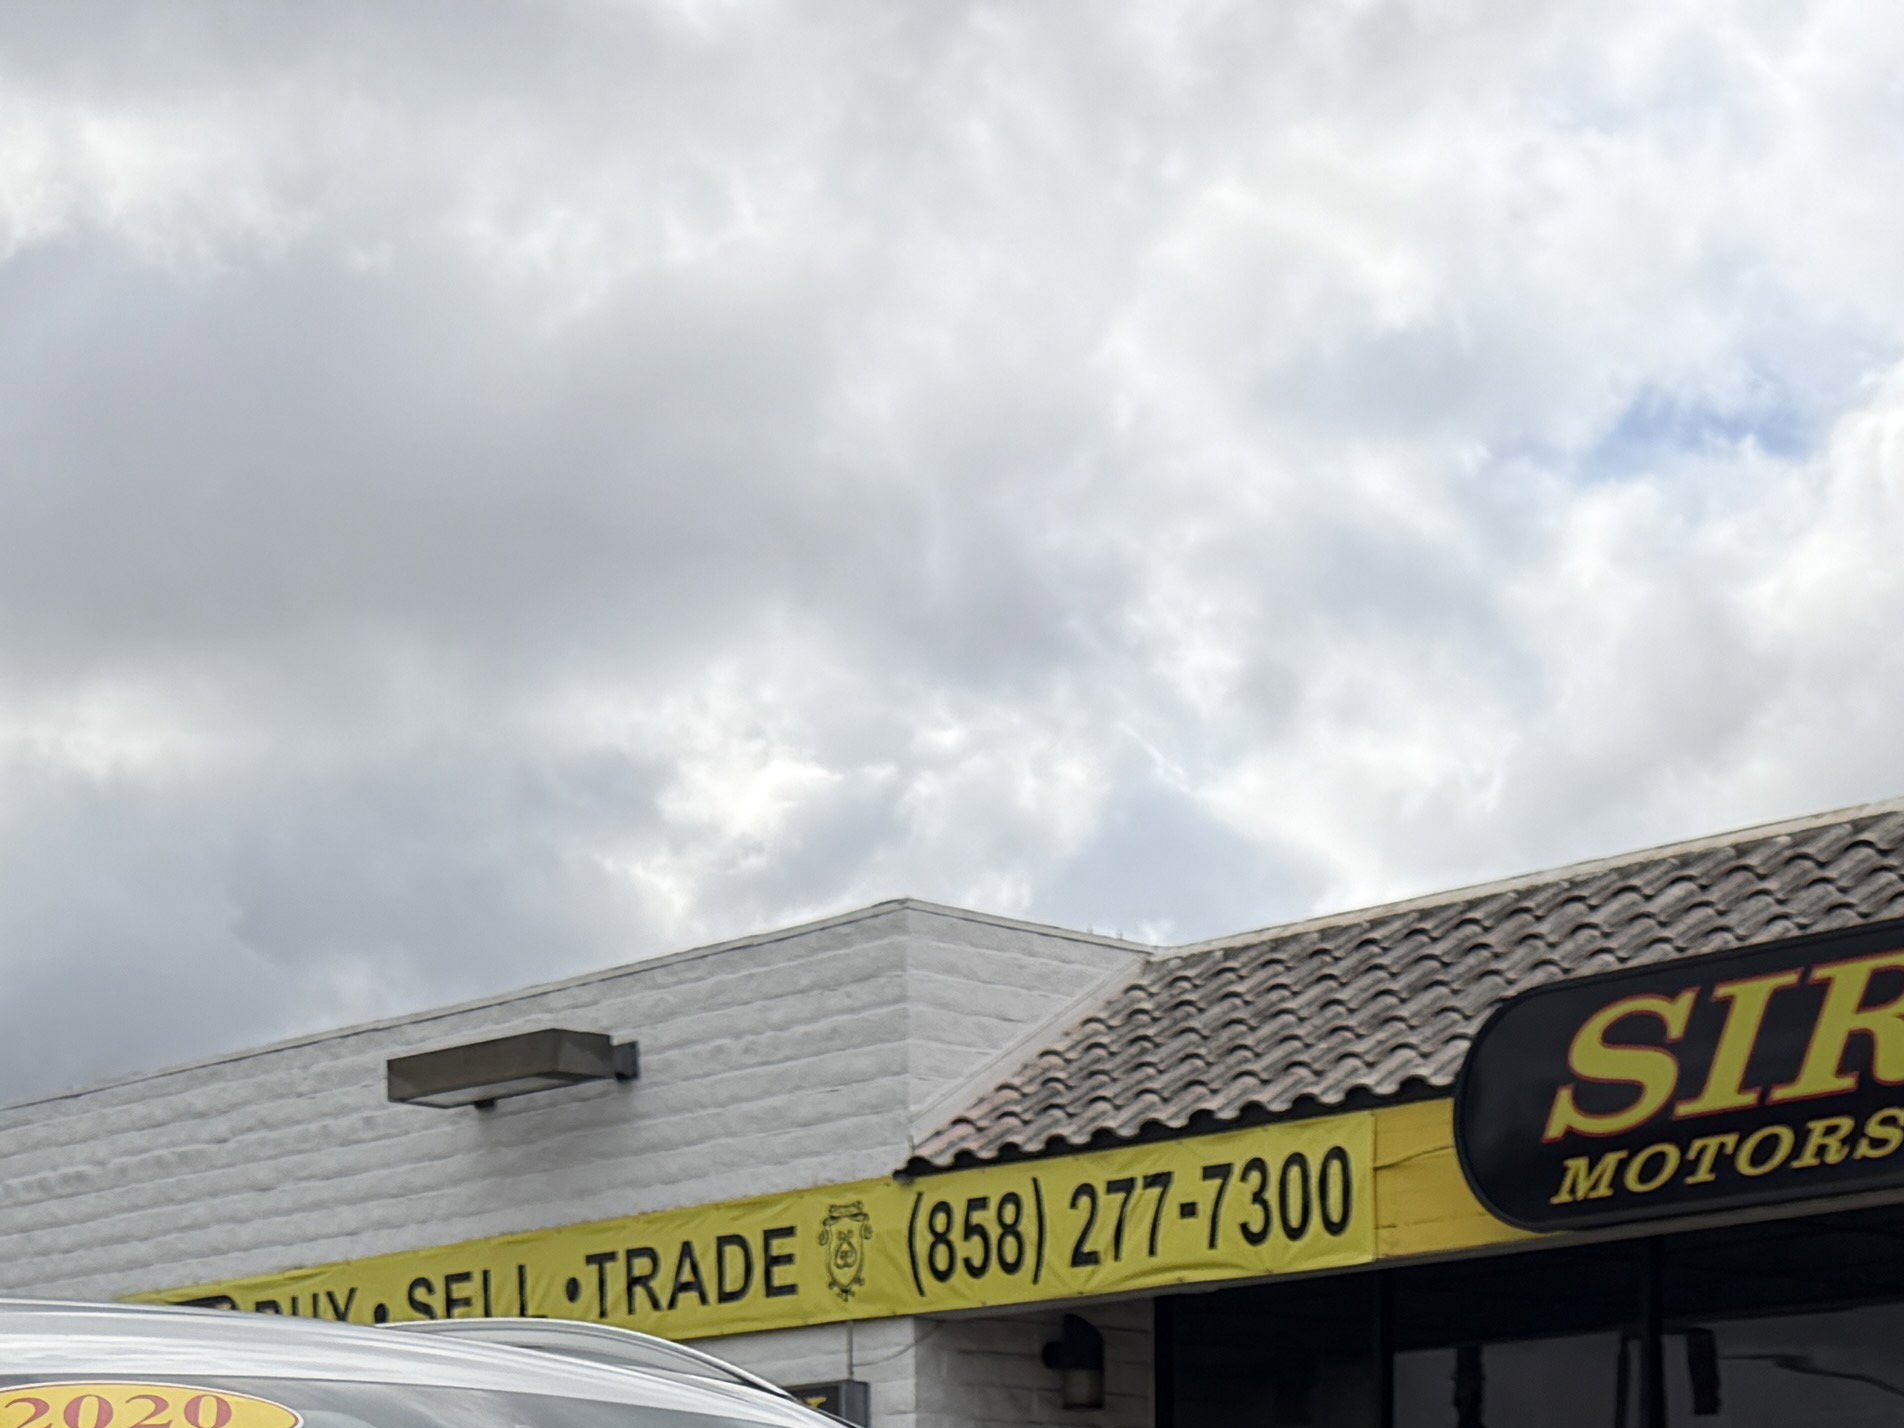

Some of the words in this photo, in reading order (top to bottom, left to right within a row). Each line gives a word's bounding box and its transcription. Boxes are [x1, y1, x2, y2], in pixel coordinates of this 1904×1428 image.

[585, 1225, 799, 1319] TRADE
[907, 1177, 1046, 1297] (858)
[1068, 1145, 1353, 1268] 277-7300
